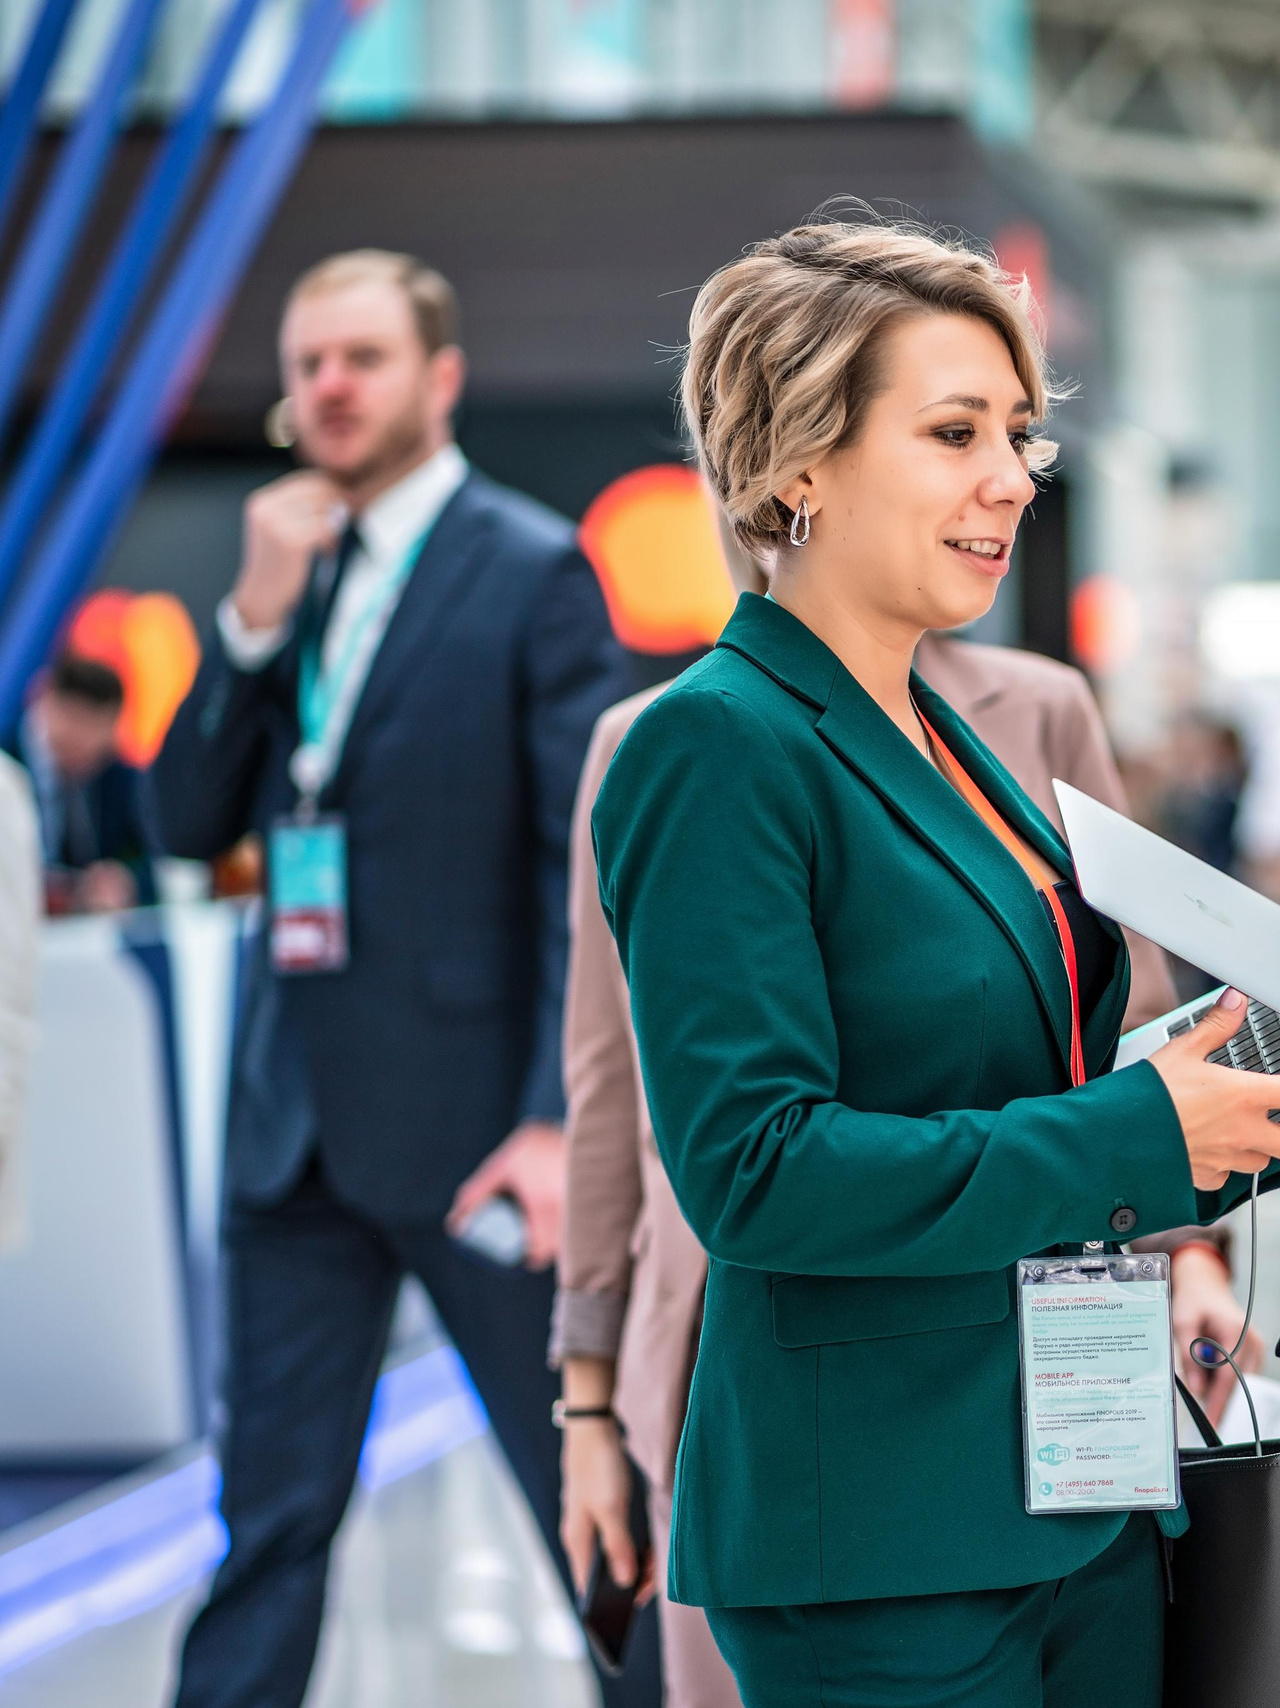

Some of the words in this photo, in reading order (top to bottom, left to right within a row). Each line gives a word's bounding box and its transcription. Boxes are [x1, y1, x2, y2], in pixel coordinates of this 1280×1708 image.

[1057, 1296, 1106, 1304] INFORMATION
[1031, 1304, 1070, 1312] ПОЛЕЗНАЯ
[1082, 1378, 1131, 1386] ПРИЛОЖЕНИЕ
[1065, 1480, 1082, 1488] (495)
[1134, 1486, 1169, 1494] finopolis.ru
